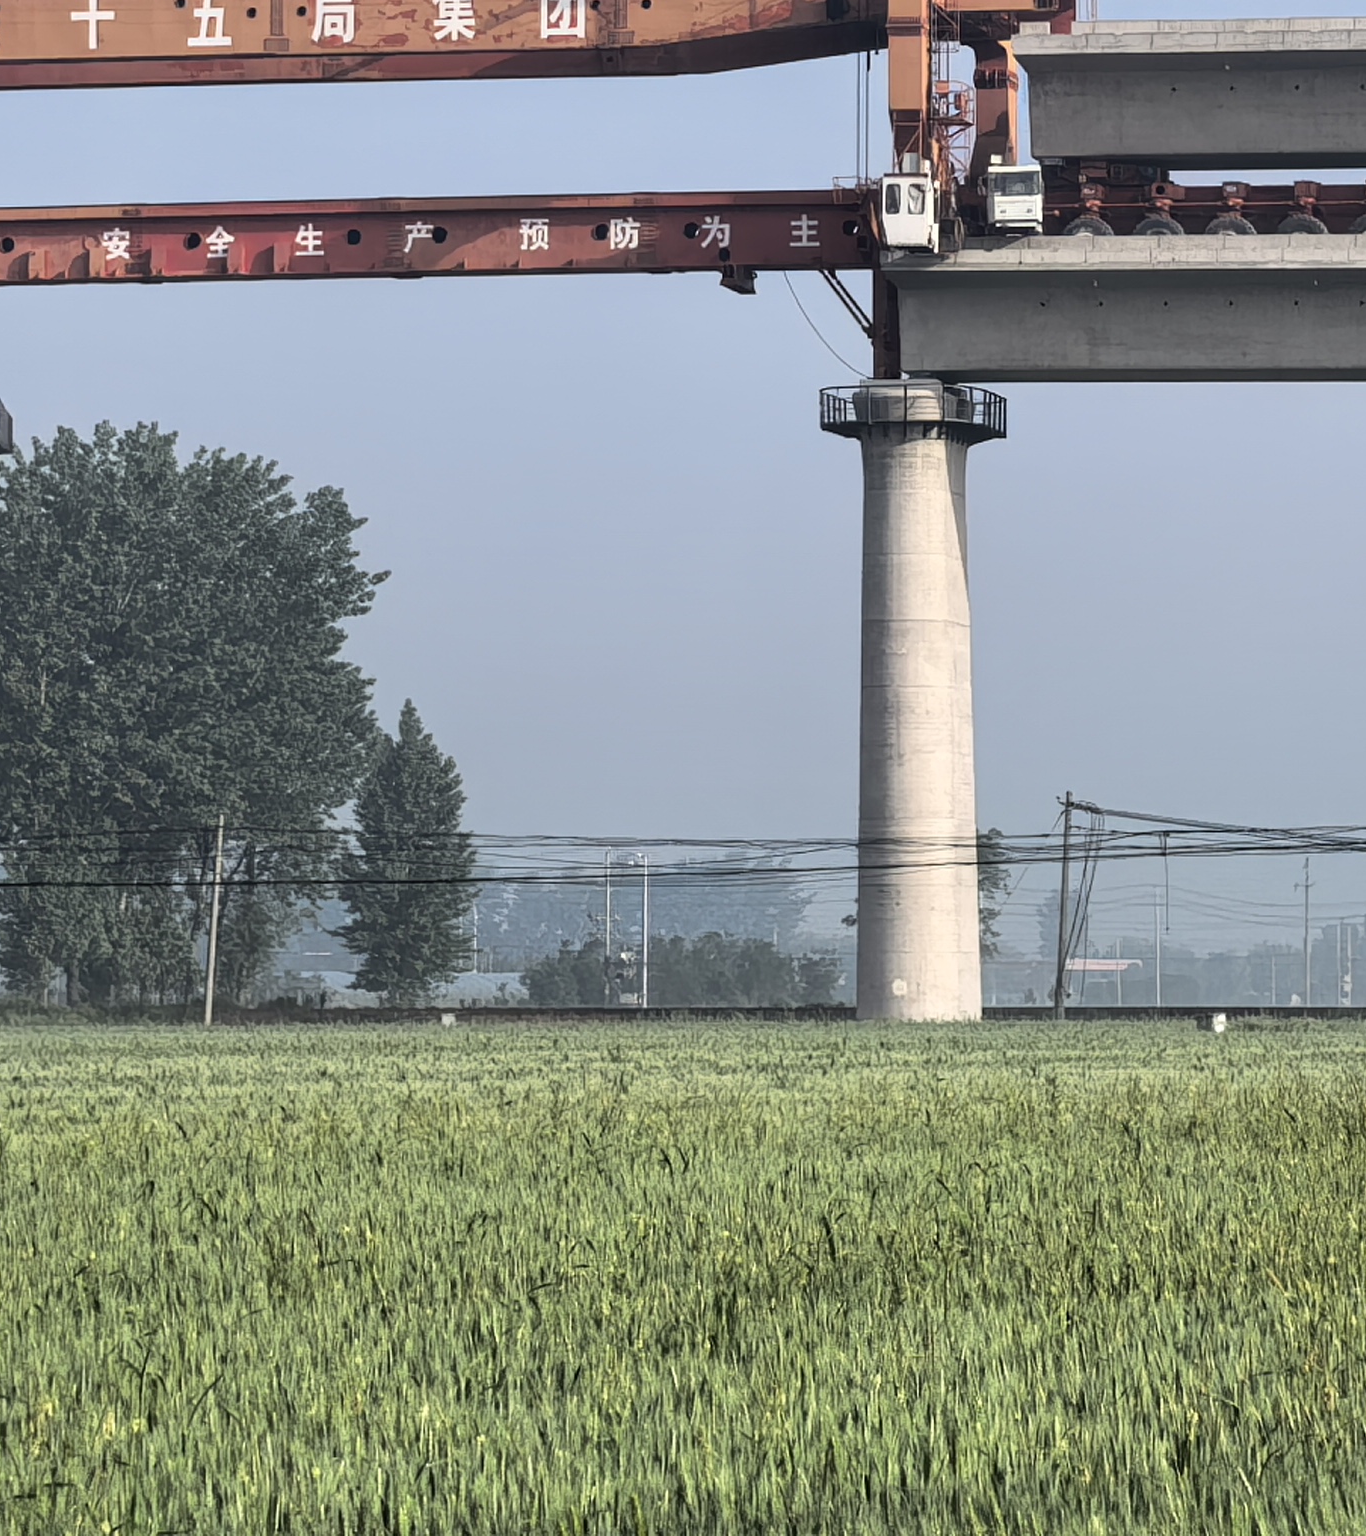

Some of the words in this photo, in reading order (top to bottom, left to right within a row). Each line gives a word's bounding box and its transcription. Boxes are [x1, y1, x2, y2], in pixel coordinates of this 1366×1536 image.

[101, 214, 820, 260] 安全生产预防为主
